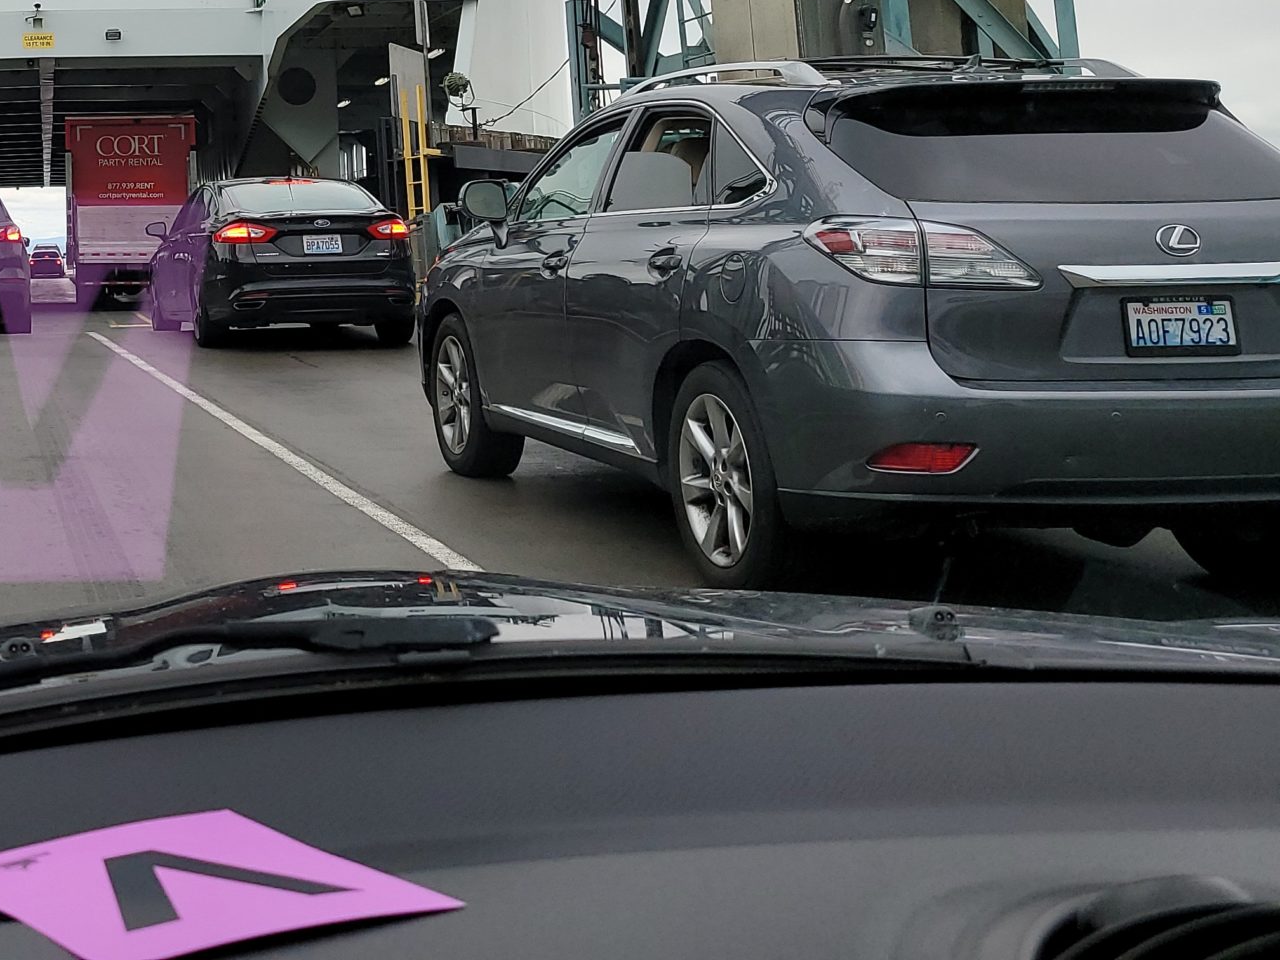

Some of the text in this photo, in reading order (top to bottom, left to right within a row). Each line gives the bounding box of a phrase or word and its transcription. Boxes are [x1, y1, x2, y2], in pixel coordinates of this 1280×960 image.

[96, 134, 164, 156] CORT
[98, 157, 163, 167] PARTY RENTAL
[107, 182, 155, 190] 877.939.RENT
[98, 191, 164, 200] cortpartyrental.com
[306, 240, 339, 251] BPA7055
[1133, 306, 1192, 315] WASHINGTON
[1136, 317, 1230, 346] AOF7923
